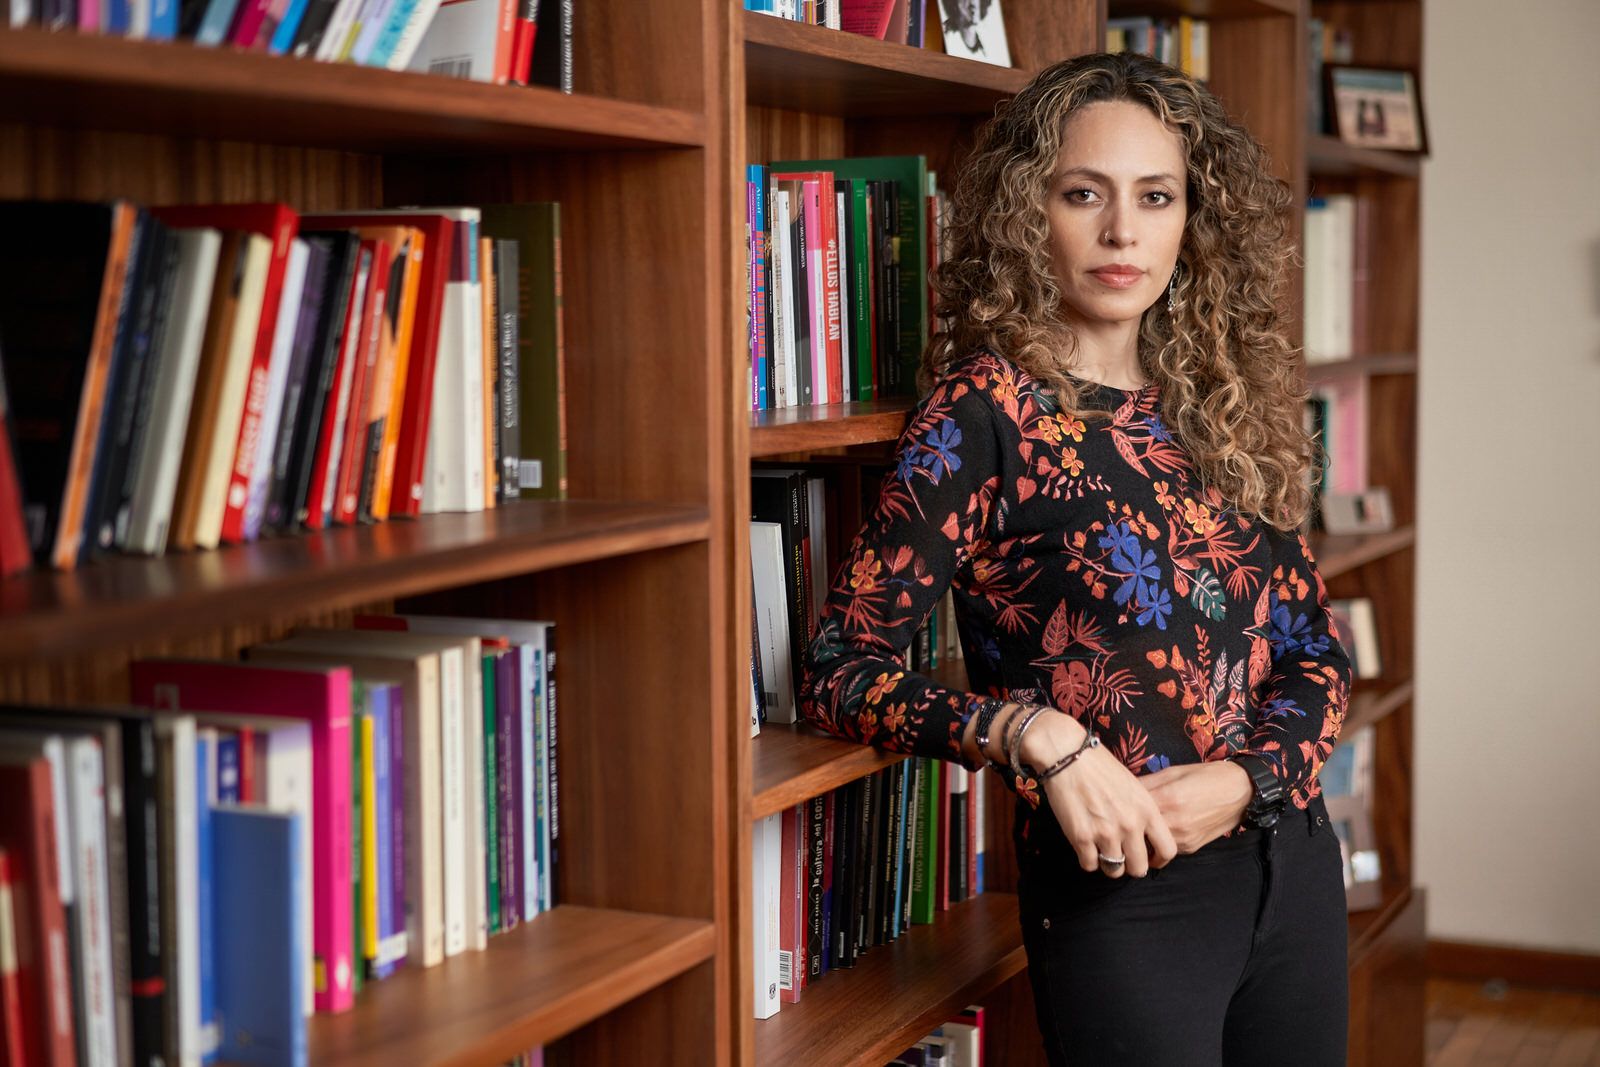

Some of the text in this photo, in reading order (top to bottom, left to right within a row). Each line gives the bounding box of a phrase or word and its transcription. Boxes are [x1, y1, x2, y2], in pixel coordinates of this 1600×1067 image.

[827, 239, 838, 288] #ELLOS
[827, 291, 840, 341] HABLAN
[917, 793, 925, 819] Penal
[814, 823, 822, 837] del
[915, 821, 924, 858] Sistema
[814, 840, 823, 875] cultura
[812, 874, 820, 888] la
[913, 860, 923, 892] Nuevo
